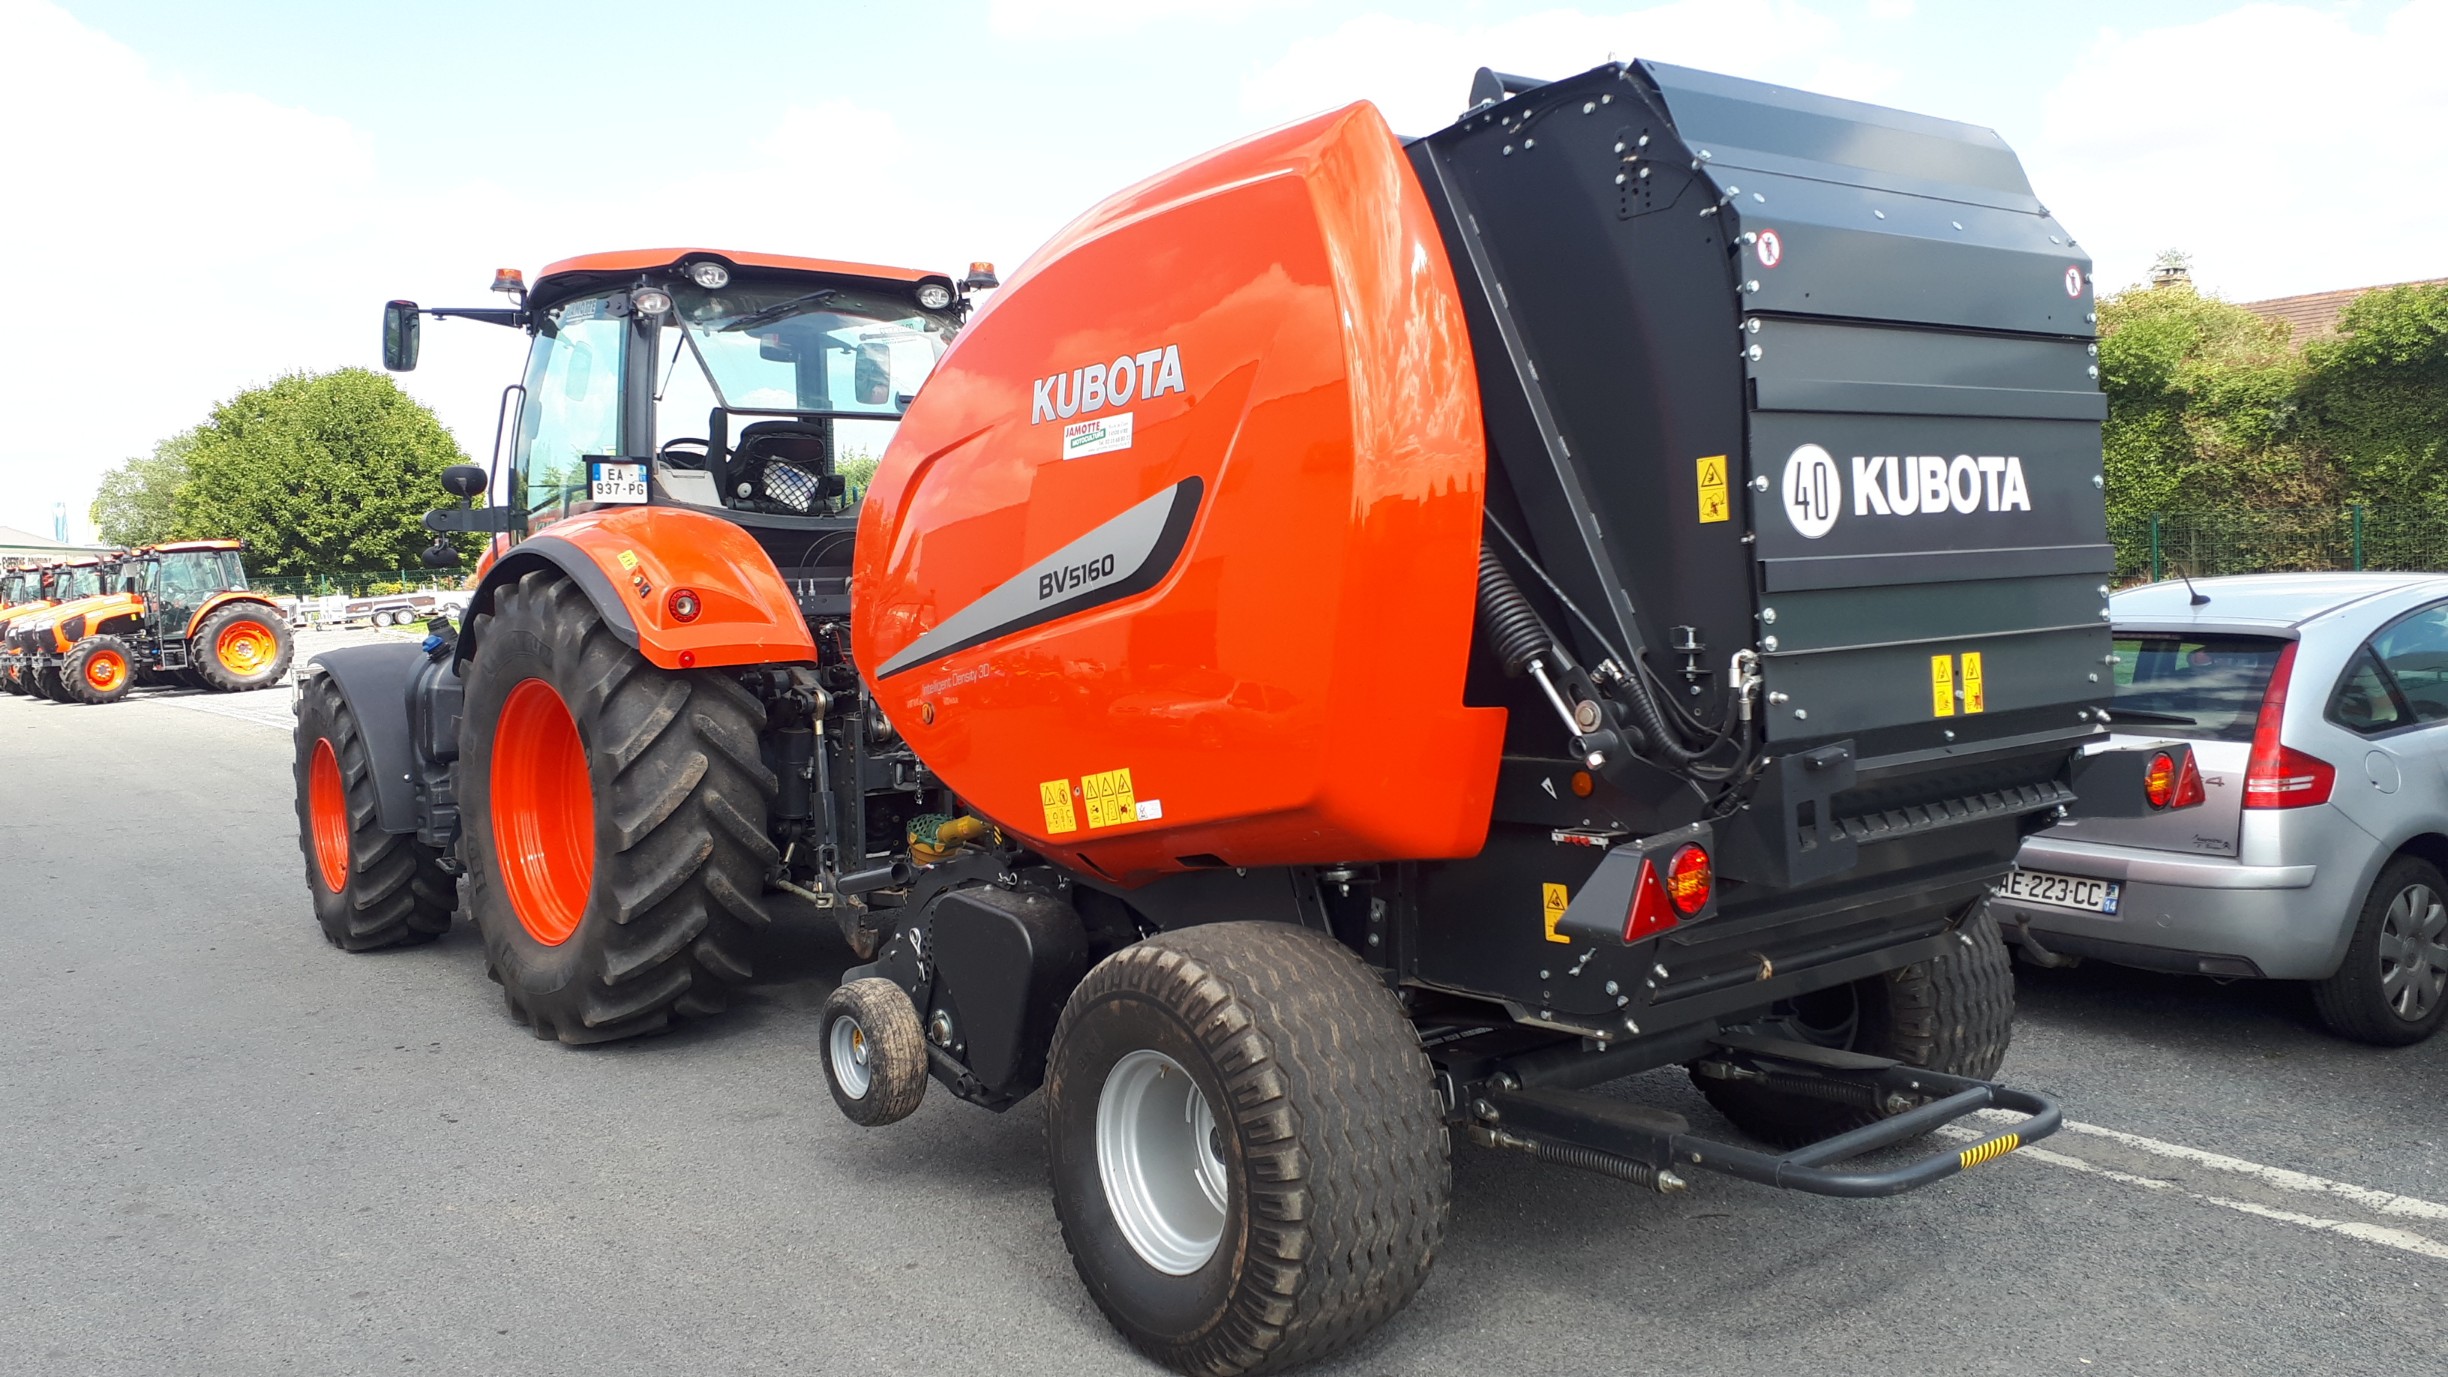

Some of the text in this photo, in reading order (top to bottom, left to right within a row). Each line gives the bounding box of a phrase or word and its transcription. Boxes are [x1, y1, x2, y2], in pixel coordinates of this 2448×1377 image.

[1031, 343, 1186, 426] KUBOTA
[1065, 421, 1101, 438] JAMOTTE
[596, 482, 644, 495] 937-PG
[608, 468, 624, 481] EA
[1794, 461, 1829, 521] 40
[1851, 454, 2032, 516] KUBOTA
[1039, 553, 1115, 601] BV5160
[922, 663, 990, 695] Intelligent Density 3D
[1999, 872, 2102, 907] AE-223-CC
[2104, 899, 2117, 912] 14
